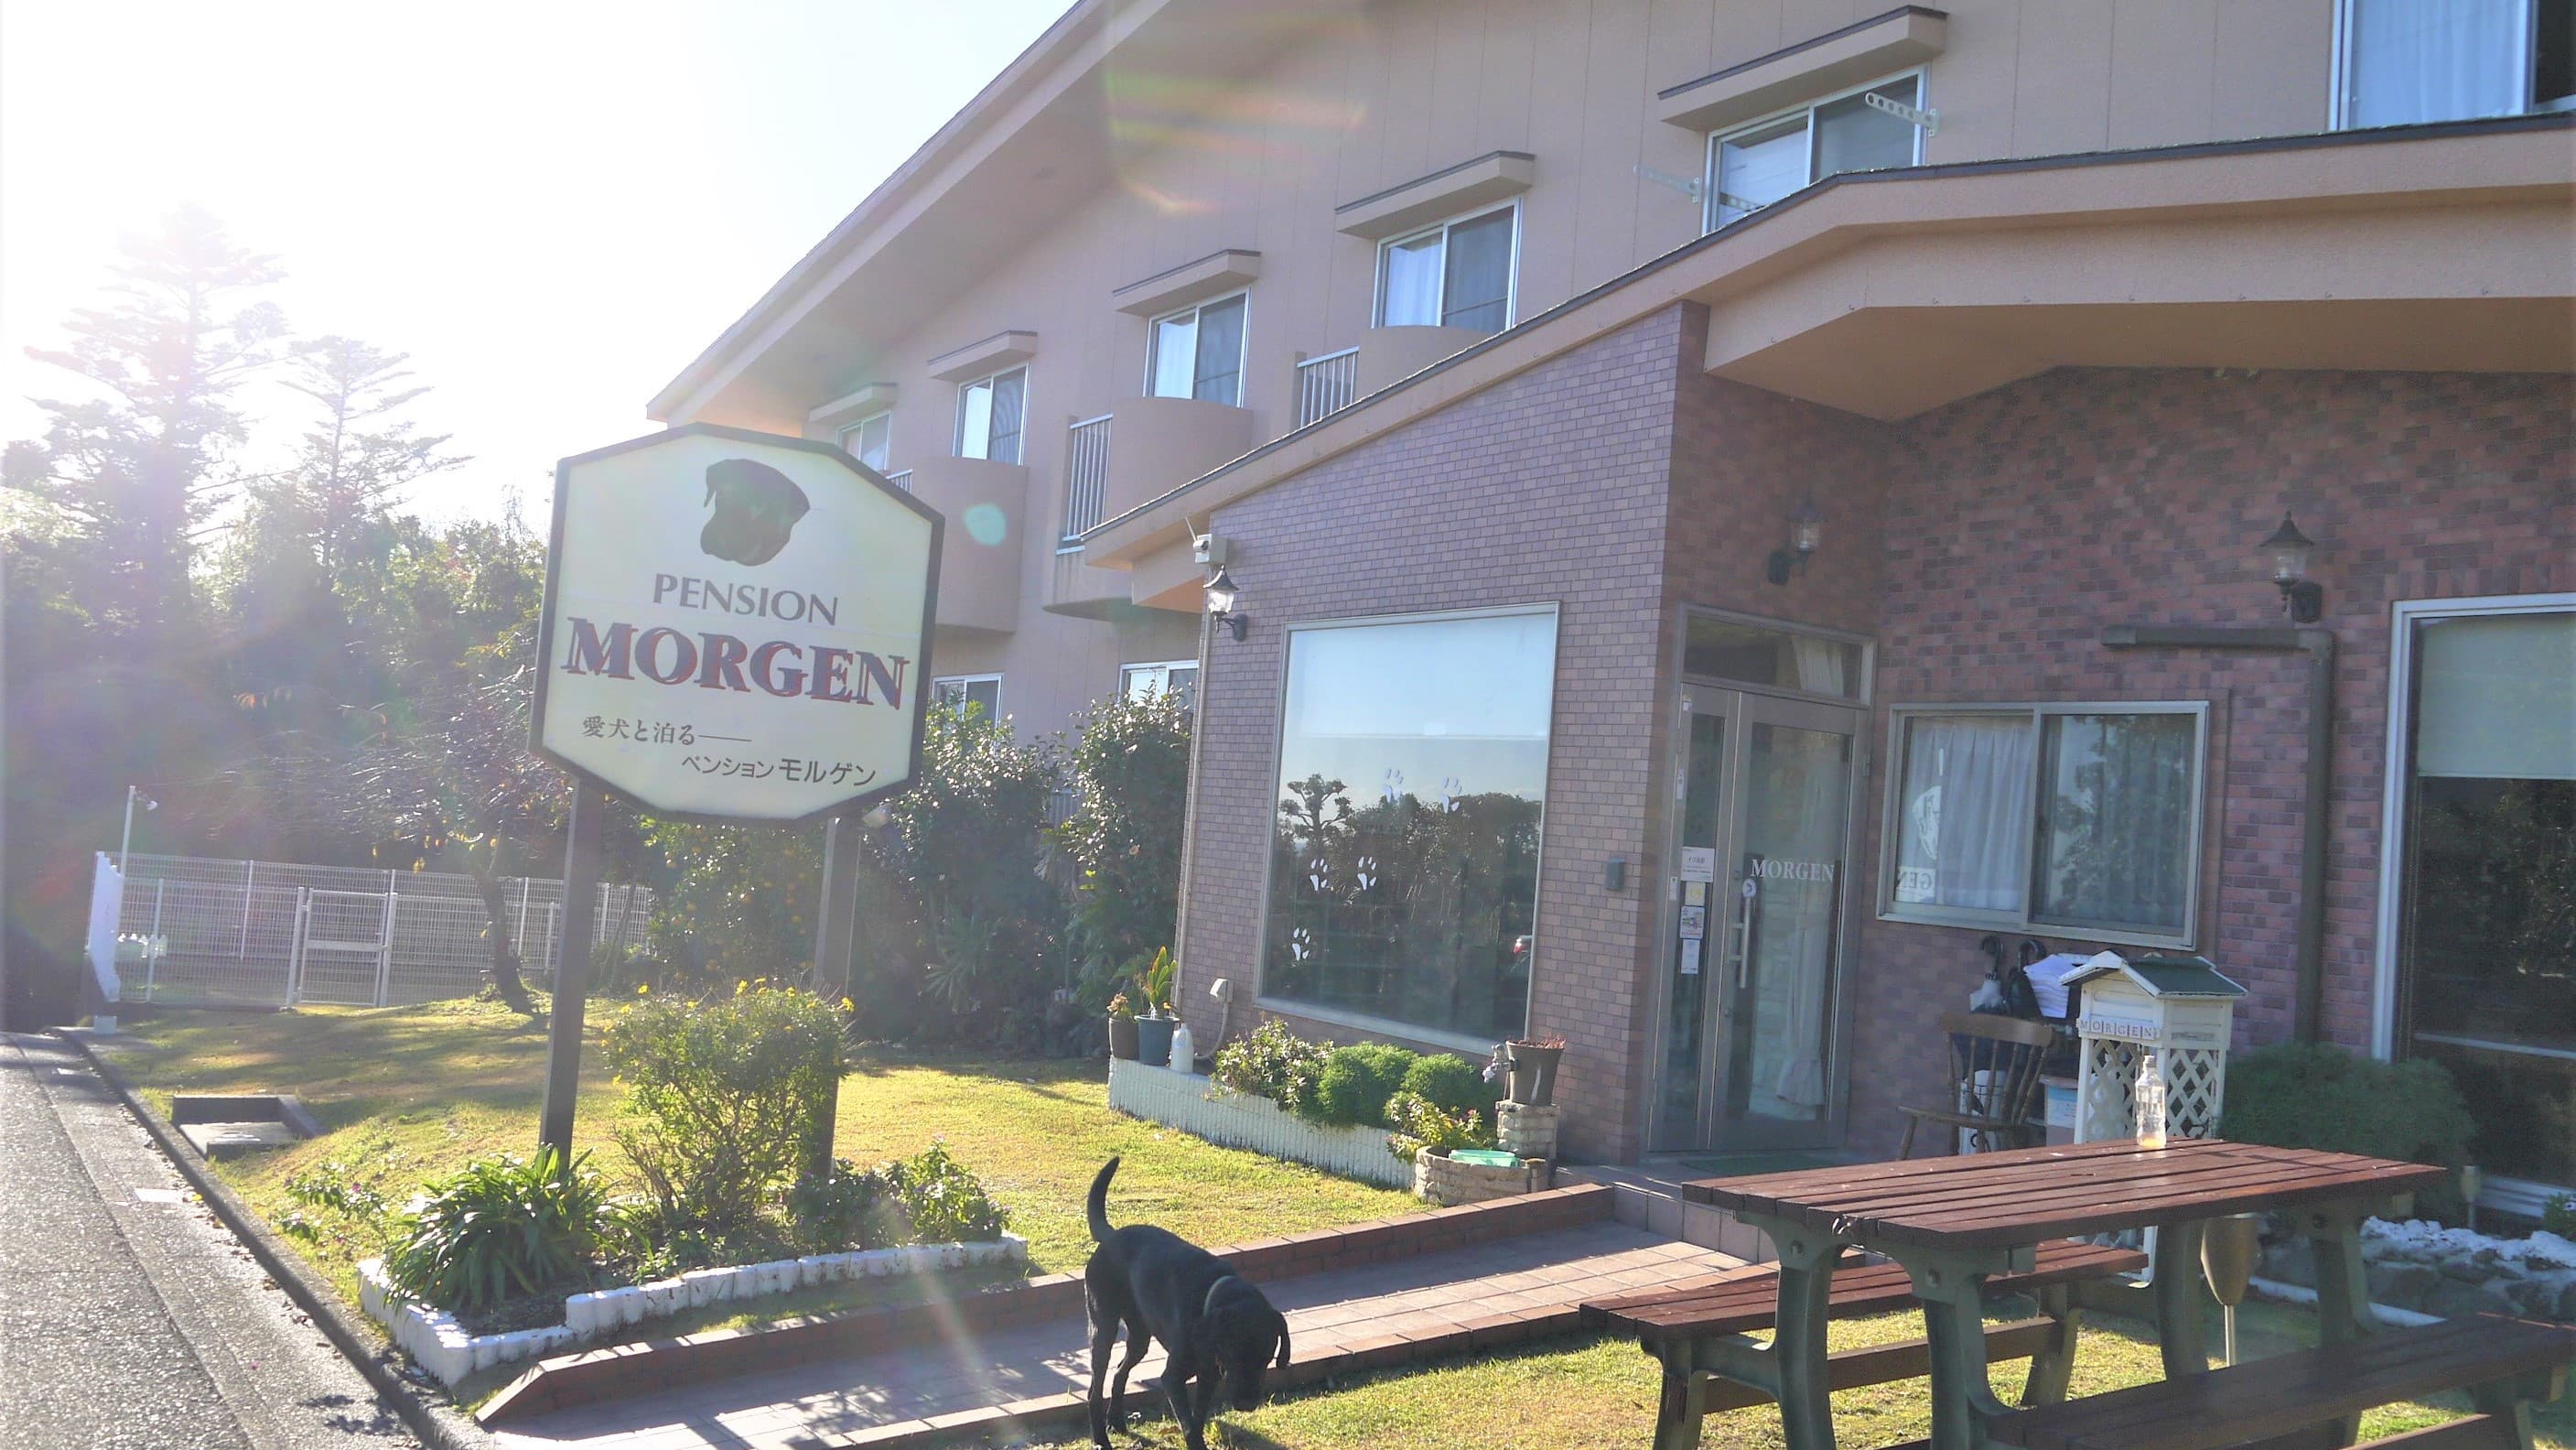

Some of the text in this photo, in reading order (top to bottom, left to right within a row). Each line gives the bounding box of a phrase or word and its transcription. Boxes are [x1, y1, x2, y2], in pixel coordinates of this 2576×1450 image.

[652, 573, 838, 626] PENSION
[560, 616, 911, 710] MORGEN
[1749, 859, 1836, 882] MORGEN
[2080, 1019, 2152, 1037] MORGEN
